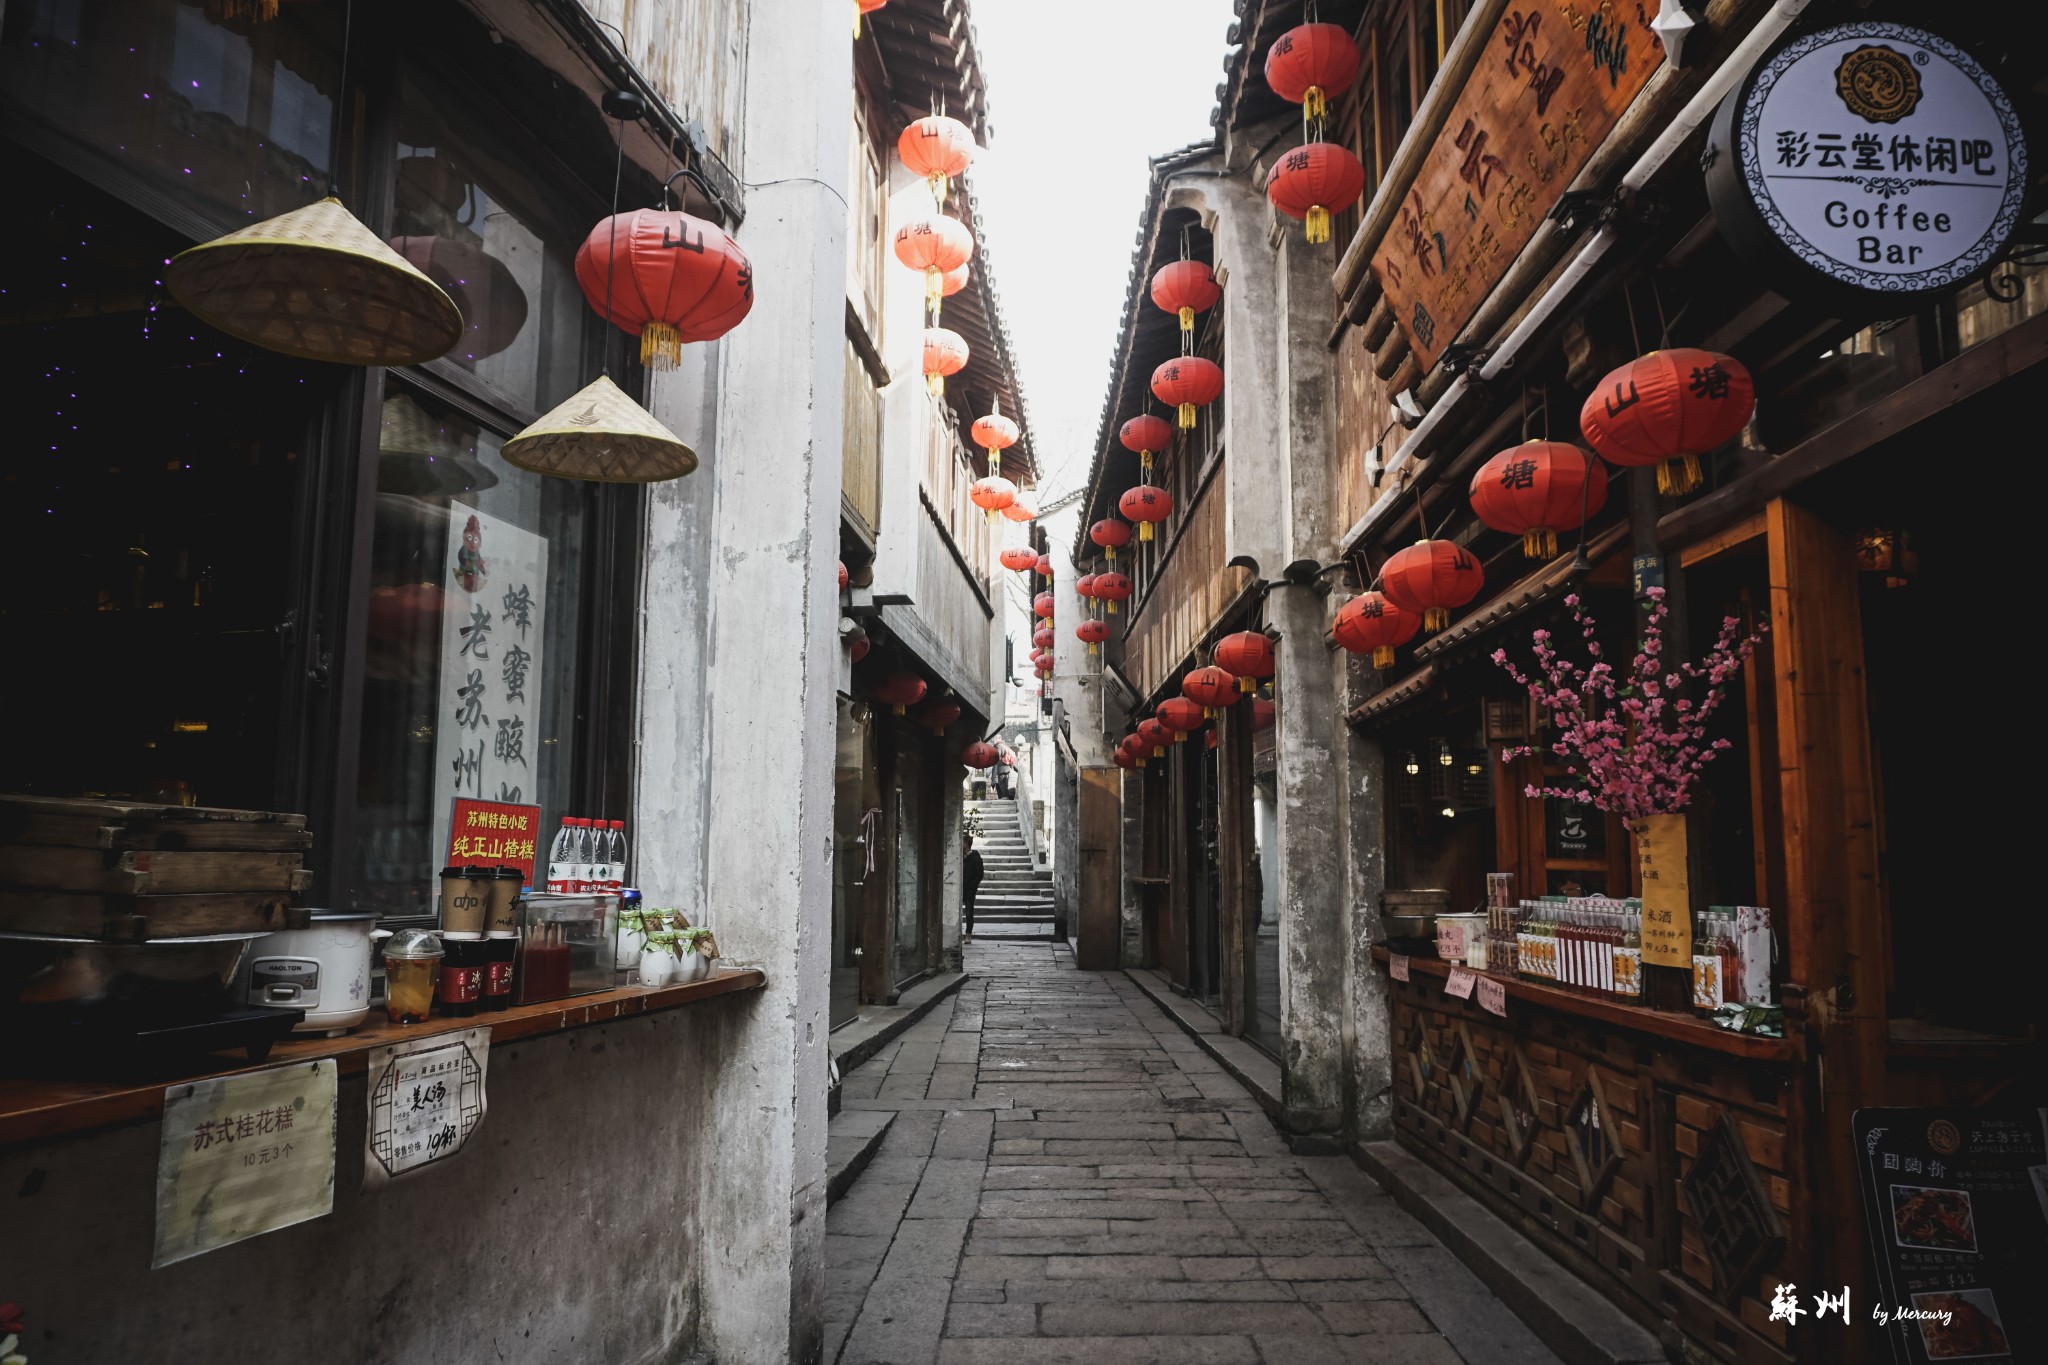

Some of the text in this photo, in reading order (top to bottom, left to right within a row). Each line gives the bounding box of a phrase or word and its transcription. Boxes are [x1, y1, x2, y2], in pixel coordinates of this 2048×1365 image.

[1776, 129, 1996, 176] 彩云堂休闲吧
[1825, 201, 1951, 233] Coffee
[1857, 236, 1923, 265] Bar
[1605, 362, 1732, 420] 山塘
[1126, 494, 1155, 506] 山塘
[453, 603, 492, 798] 老苏州
[467, 810, 528, 831] 苏州特色小吃
[451, 835, 535, 860] 纯正山楂糕
[194, 1104, 294, 1151] 苏式桂花糕
[1882, 1152, 1947, 1179] 团购价
